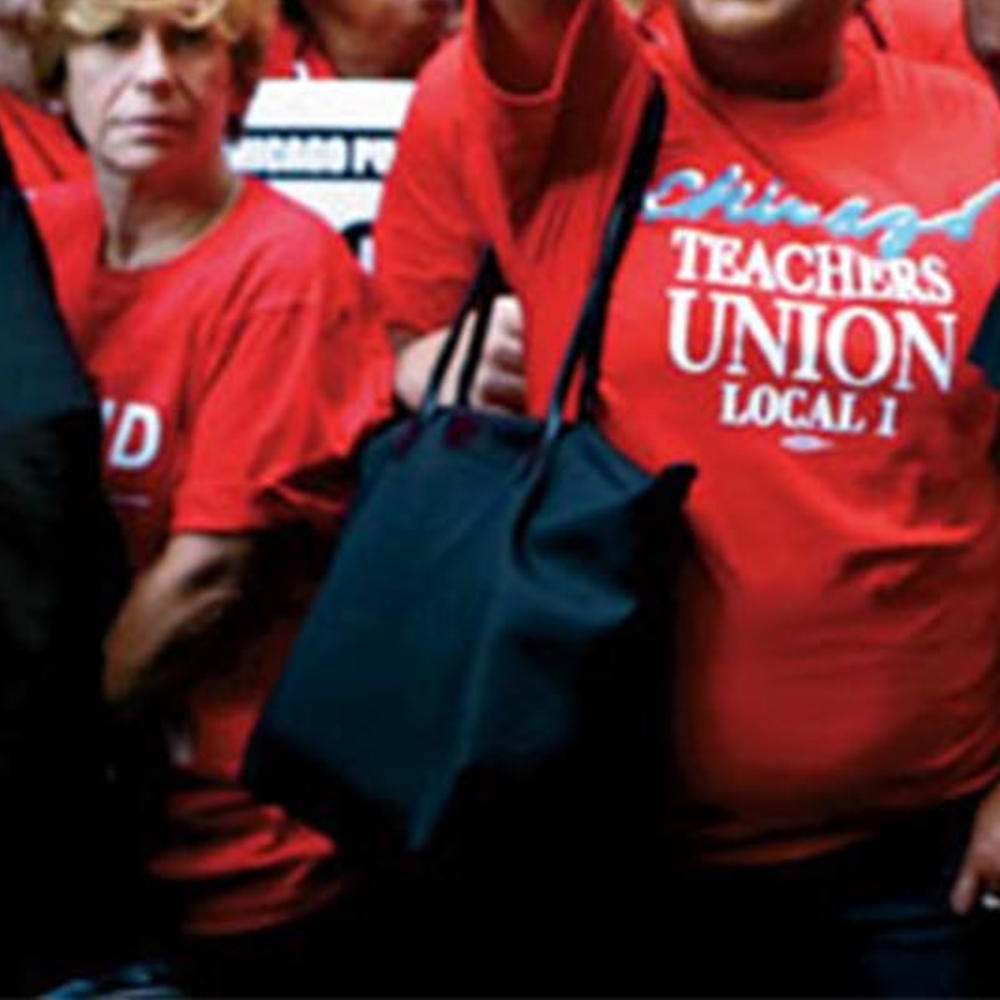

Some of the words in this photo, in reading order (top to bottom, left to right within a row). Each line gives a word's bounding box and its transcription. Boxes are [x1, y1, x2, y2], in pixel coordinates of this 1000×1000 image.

[671, 227, 956, 305] TEACHERS
[667, 288, 959, 394] UNION
[719, 382, 866, 434] LOCAL
